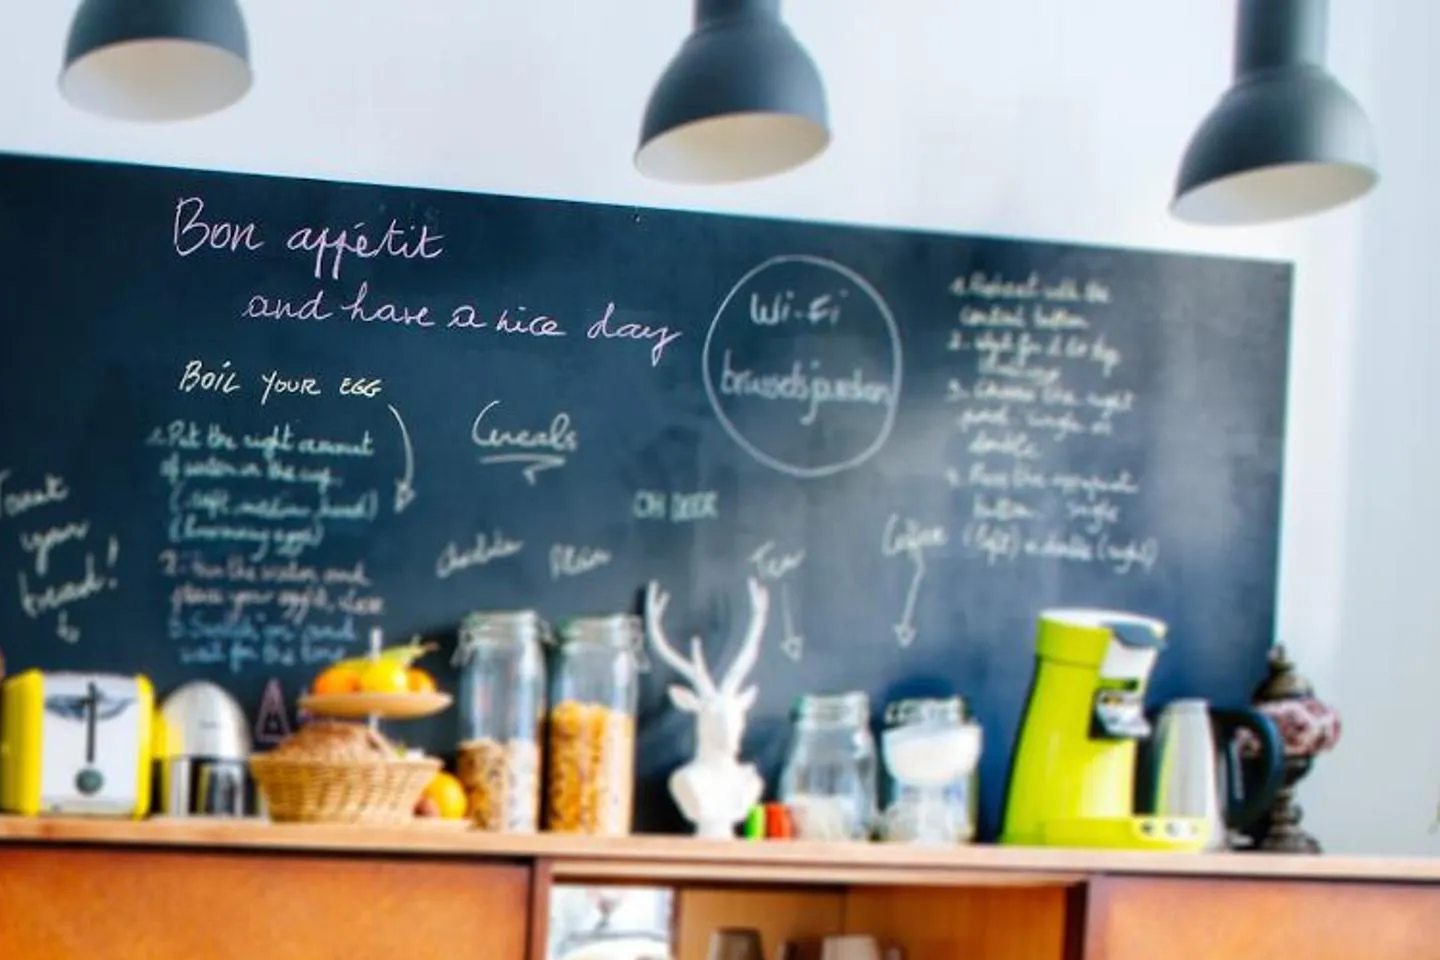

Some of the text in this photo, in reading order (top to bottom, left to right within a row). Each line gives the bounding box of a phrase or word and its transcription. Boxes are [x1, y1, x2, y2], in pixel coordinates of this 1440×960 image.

[173, 197, 445, 280] Bon appétit
[242, 282, 683, 367] and have a nice day
[261, 370, 321, 405] YOUR
[339, 377, 383, 398] EGG
